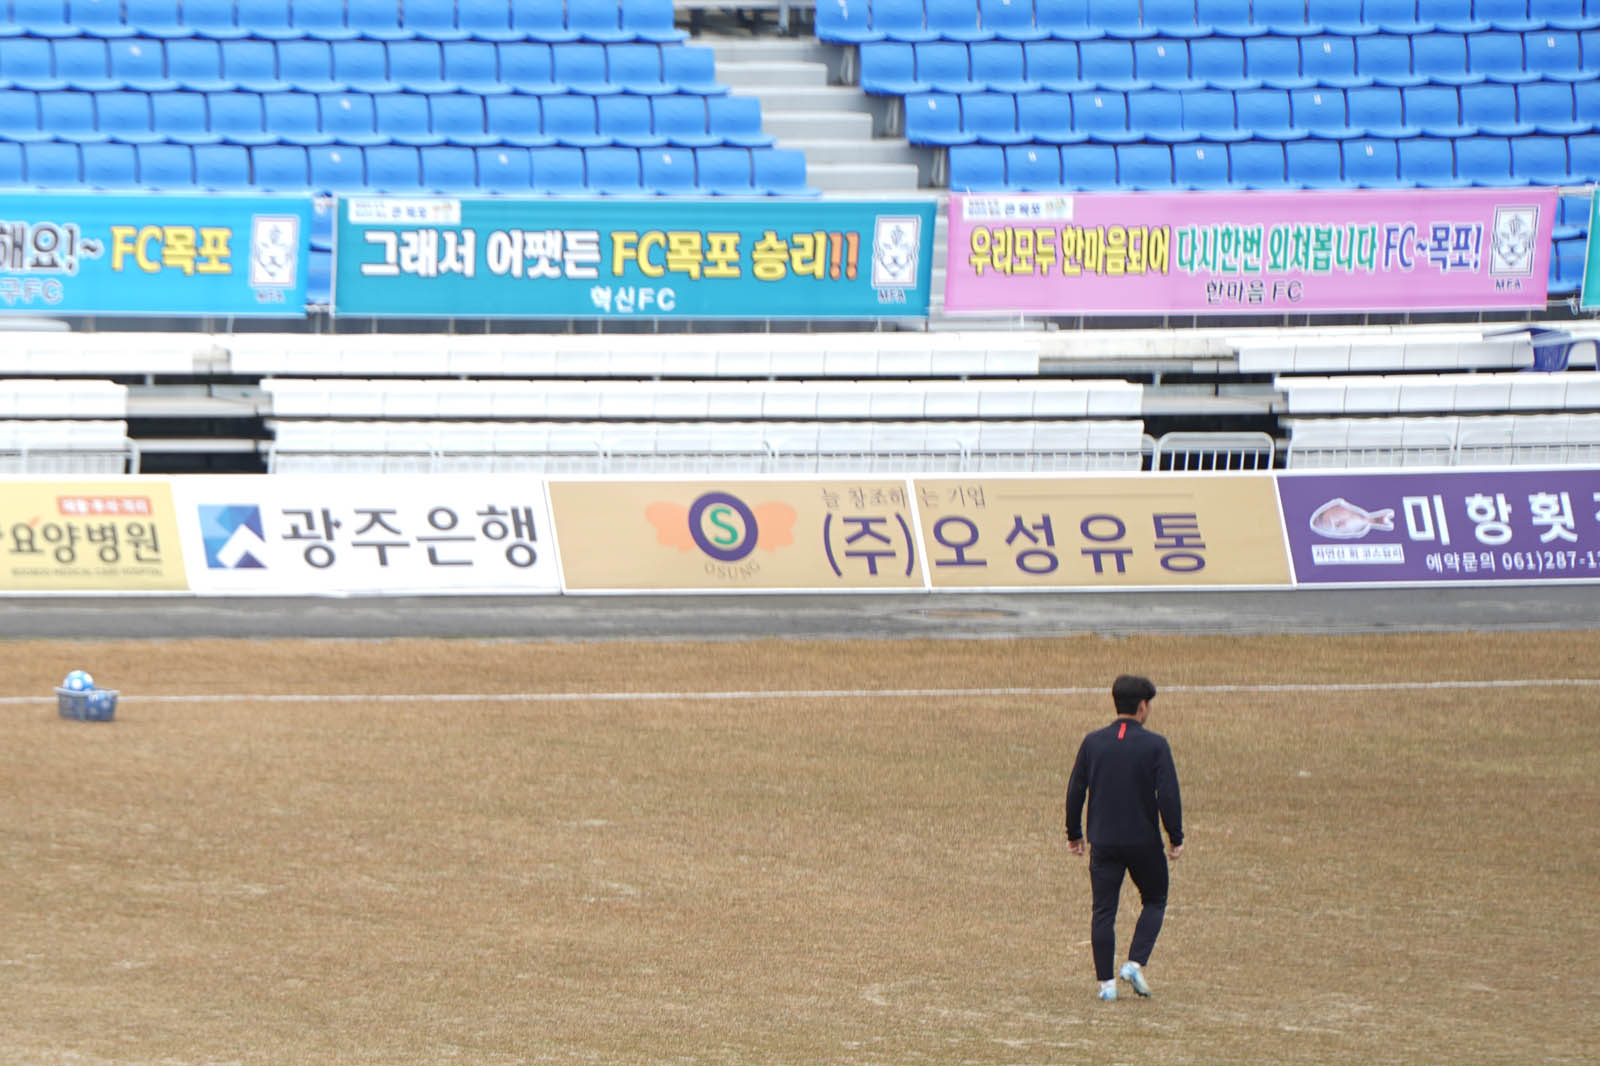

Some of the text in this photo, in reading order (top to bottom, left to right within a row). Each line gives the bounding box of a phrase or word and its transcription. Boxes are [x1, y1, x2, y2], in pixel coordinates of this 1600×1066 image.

[110, 224, 233, 276] FC목포
[361, 228, 477, 278] 그래서
[610, 229, 741, 280] FC목포
[751, 230, 861, 281] 승리!!
[969, 222, 1484, 276] 우리모두 한마음되어 다시한번 외쳐봅니다 FC~목포!
[1206, 279, 1304, 305] 한마음 FC
[1495, 279, 1522, 291] MFA
[950, 485, 987, 508] 기업
[1402, 491, 1600, 547] 미항횟
[281, 504, 538, 570] 광주은행
[823, 512, 1207, 578] (주) 오성유통
[1425, 551, 1496, 574] 예약문의
[704, 559, 761, 581] OSUNG
